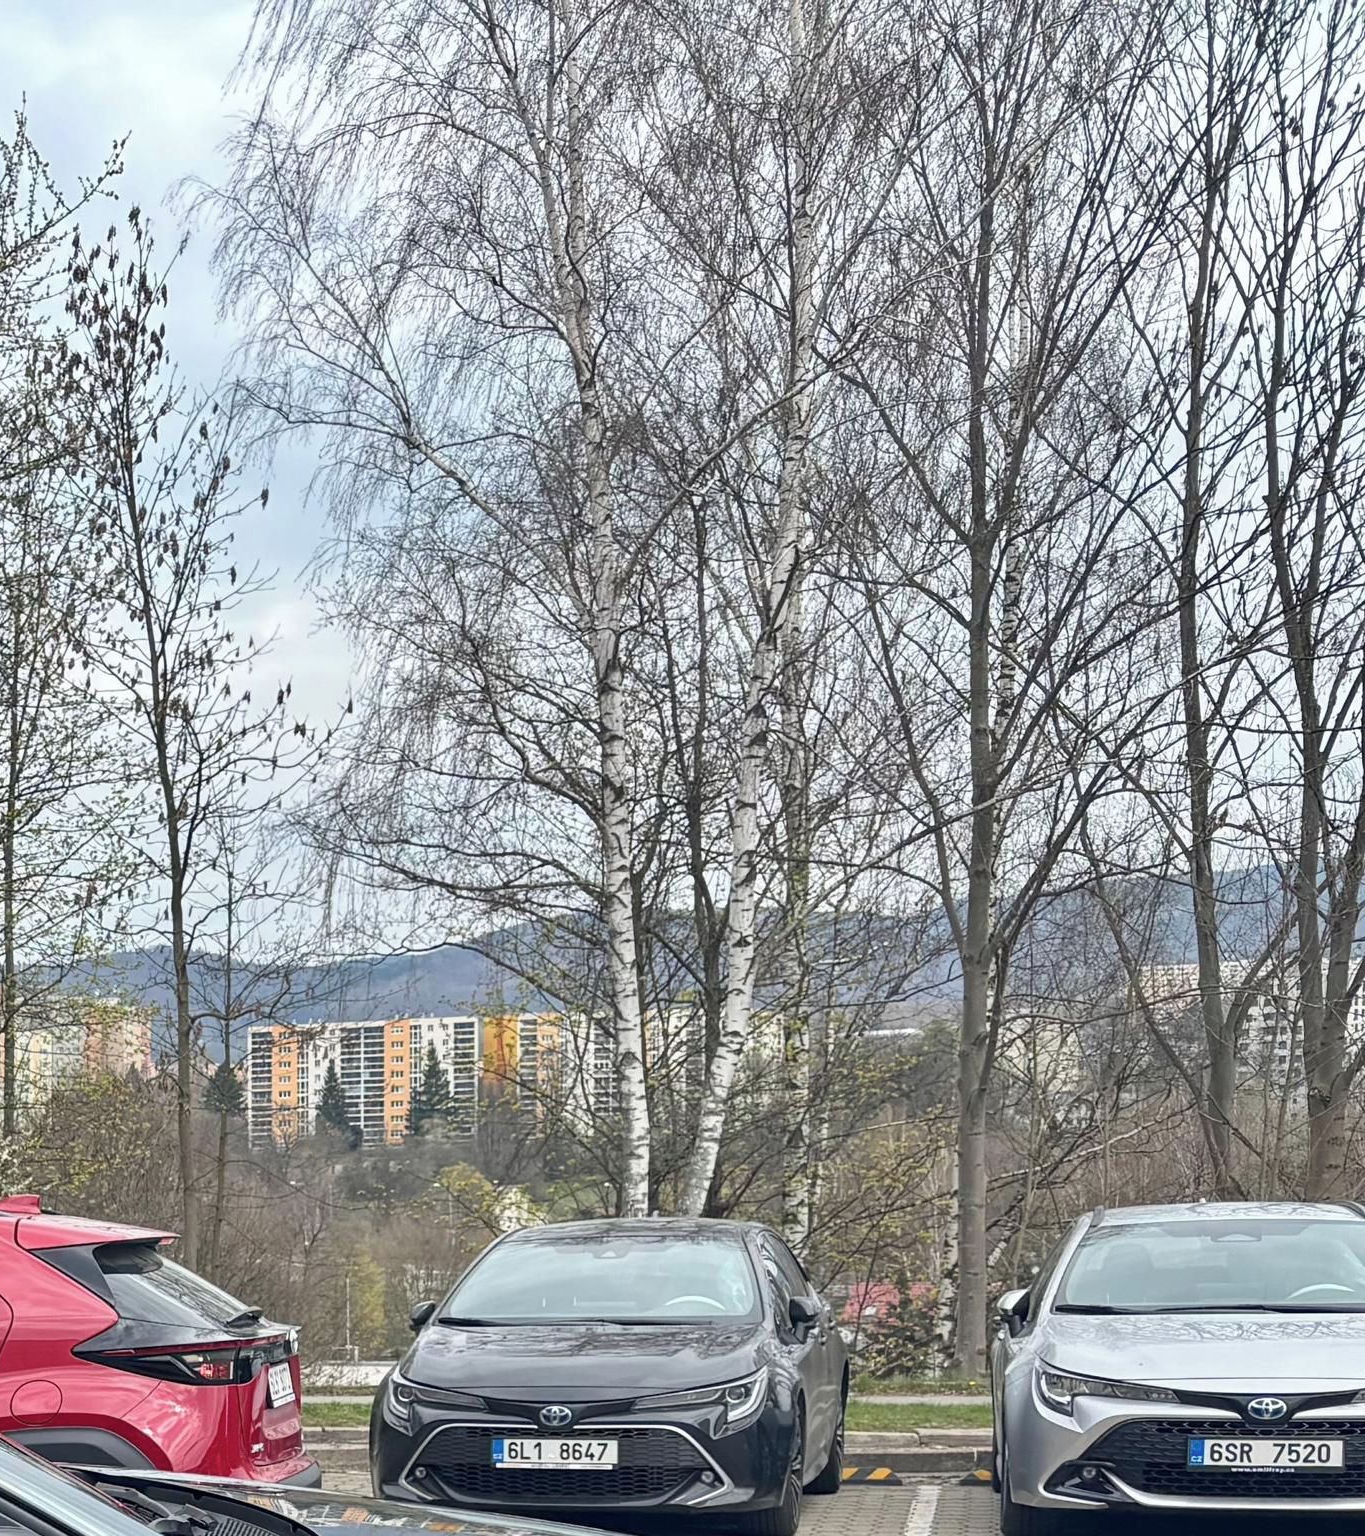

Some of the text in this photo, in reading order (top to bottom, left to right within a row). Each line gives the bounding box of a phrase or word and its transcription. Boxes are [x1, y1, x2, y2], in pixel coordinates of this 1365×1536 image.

[507, 1442, 608, 1461] 6L1 8647
[1191, 1455, 1203, 1463] CZ
[1209, 1443, 1331, 1463] 6SR 7520
